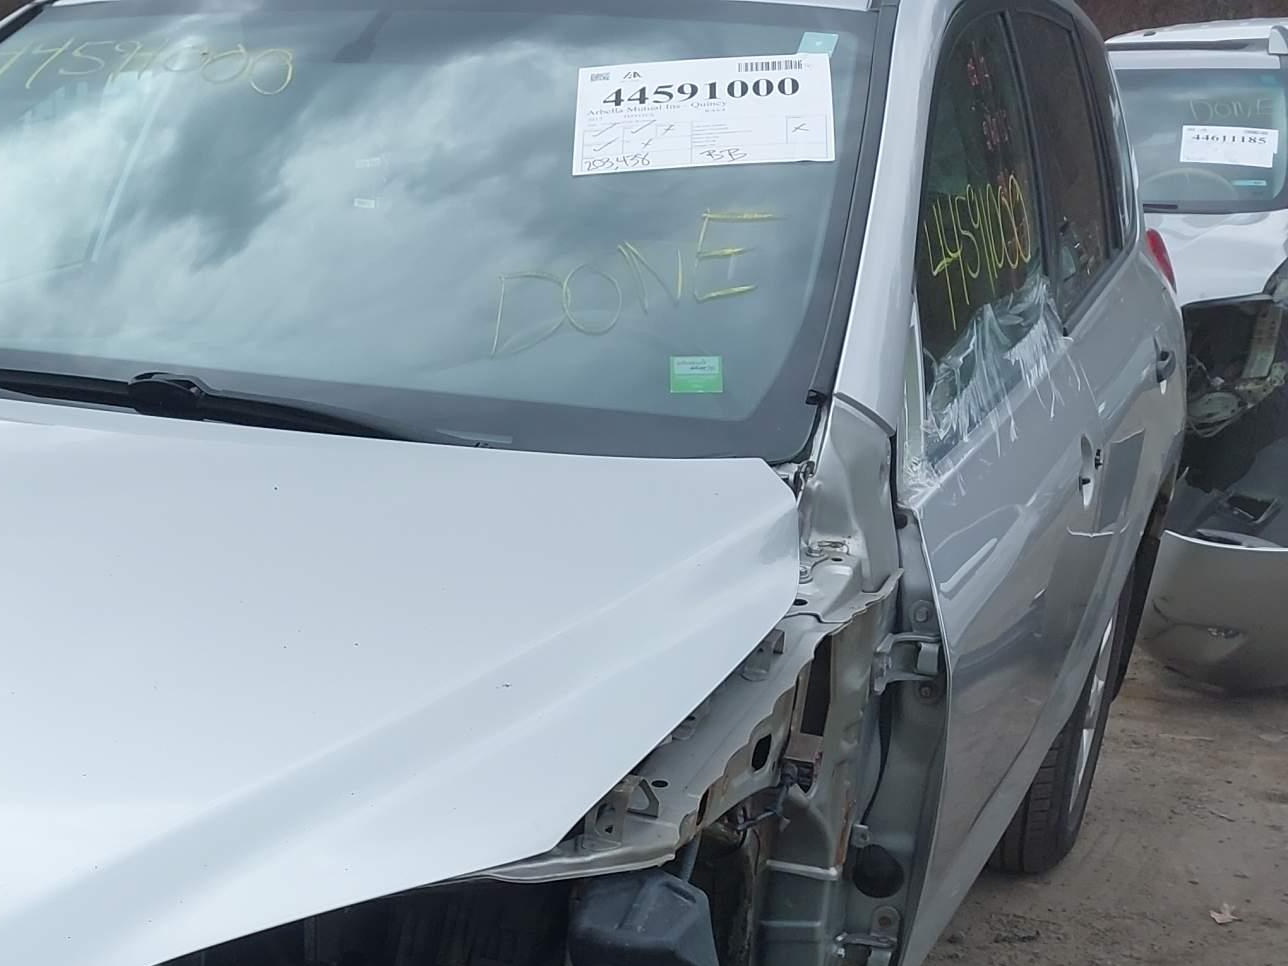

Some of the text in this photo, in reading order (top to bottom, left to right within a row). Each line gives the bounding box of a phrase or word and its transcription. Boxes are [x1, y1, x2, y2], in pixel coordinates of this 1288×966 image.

[602, 77, 801, 107] 44591000
[1192, 134, 1267, 144] 44611185
[490, 208, 788, 360] DONE
[923, 174, 1032, 331] 44591000
